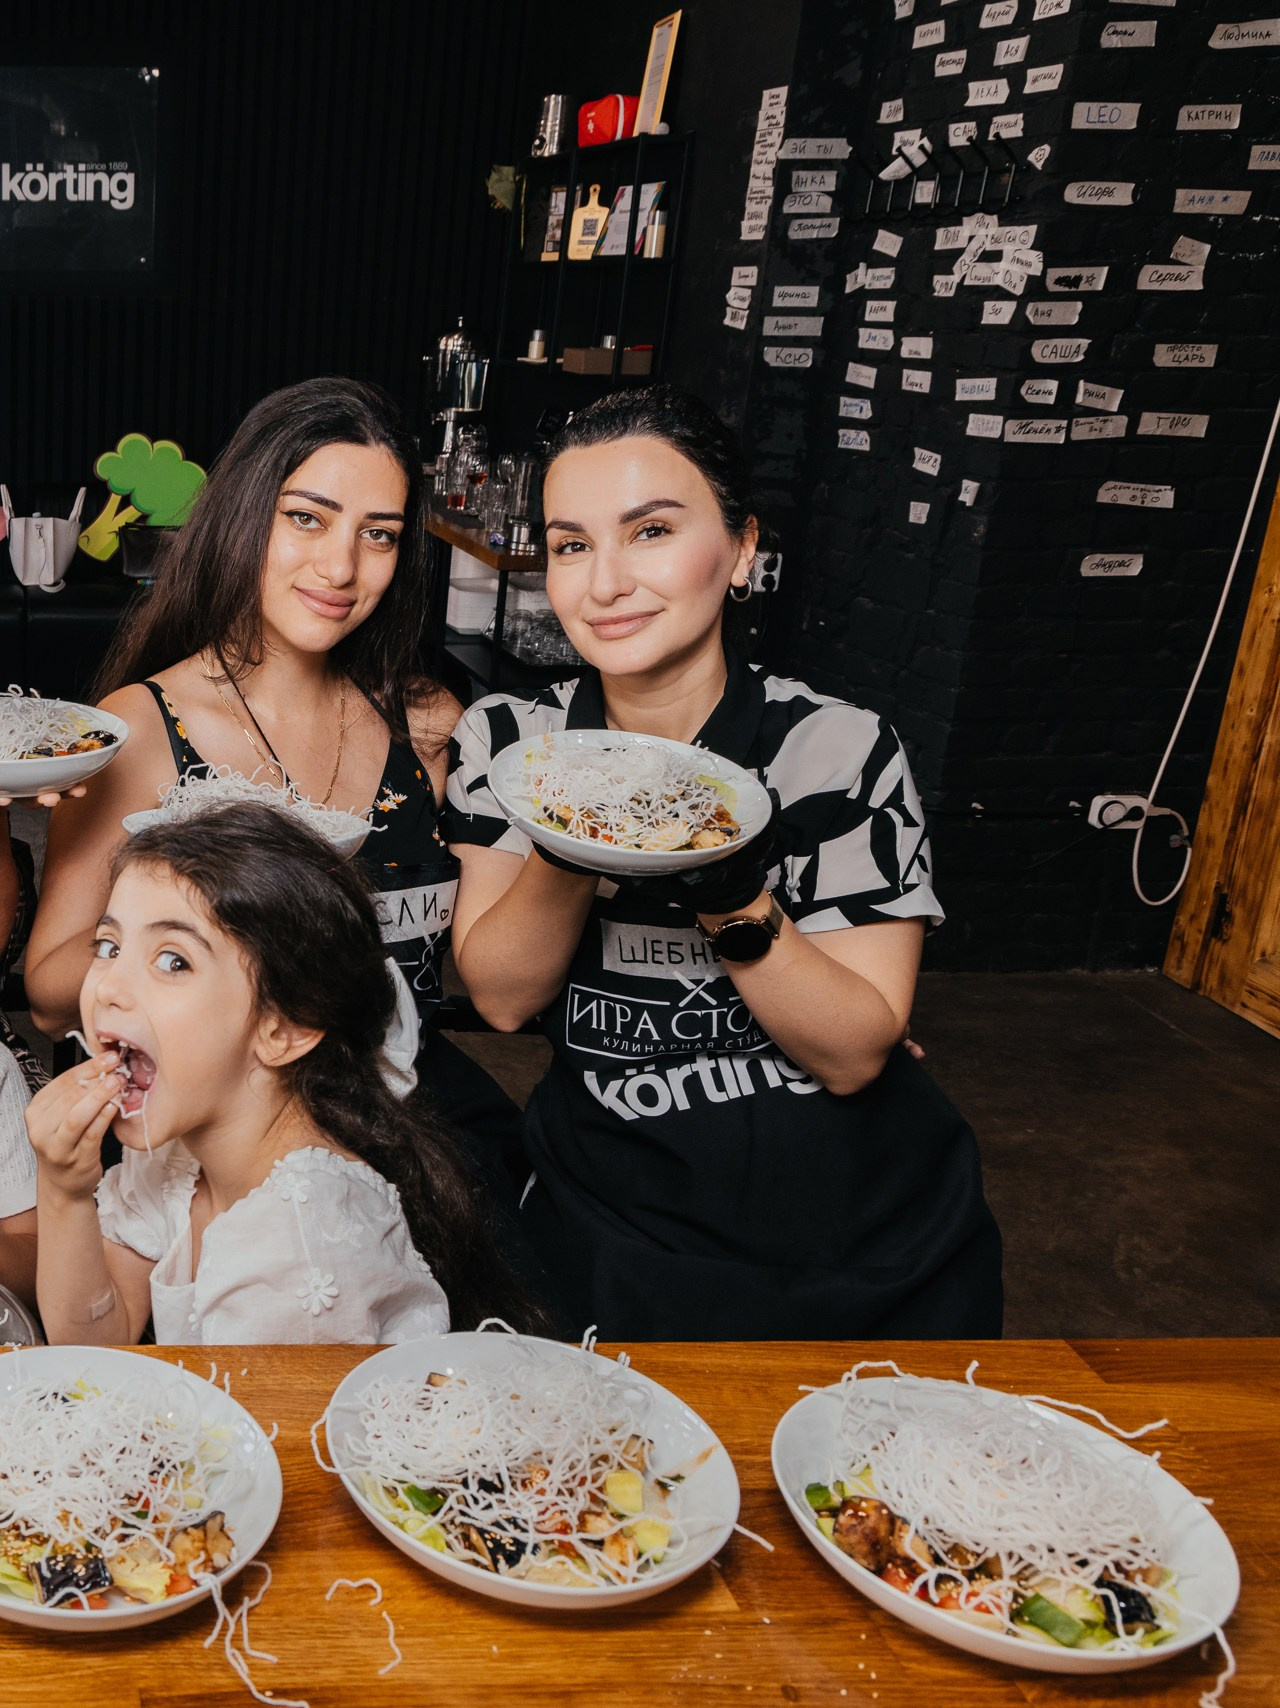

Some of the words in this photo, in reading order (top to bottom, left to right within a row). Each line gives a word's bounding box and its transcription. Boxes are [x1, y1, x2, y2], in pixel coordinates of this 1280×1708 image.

[1086, 106, 1122, 124] LEO
[1187, 110, 1233, 122] КАТРИН
[2, 163, 135, 210] körting
[1040, 344, 1082, 359] САША
[572, 993, 661, 1041] ИГРА
[671, 1008, 753, 1039] СТО
[603, 1035, 714, 1053] КУЛИНАРНАЯ
[725, 1029, 765, 1049] СТУД
[583, 1050, 823, 1121] körting
